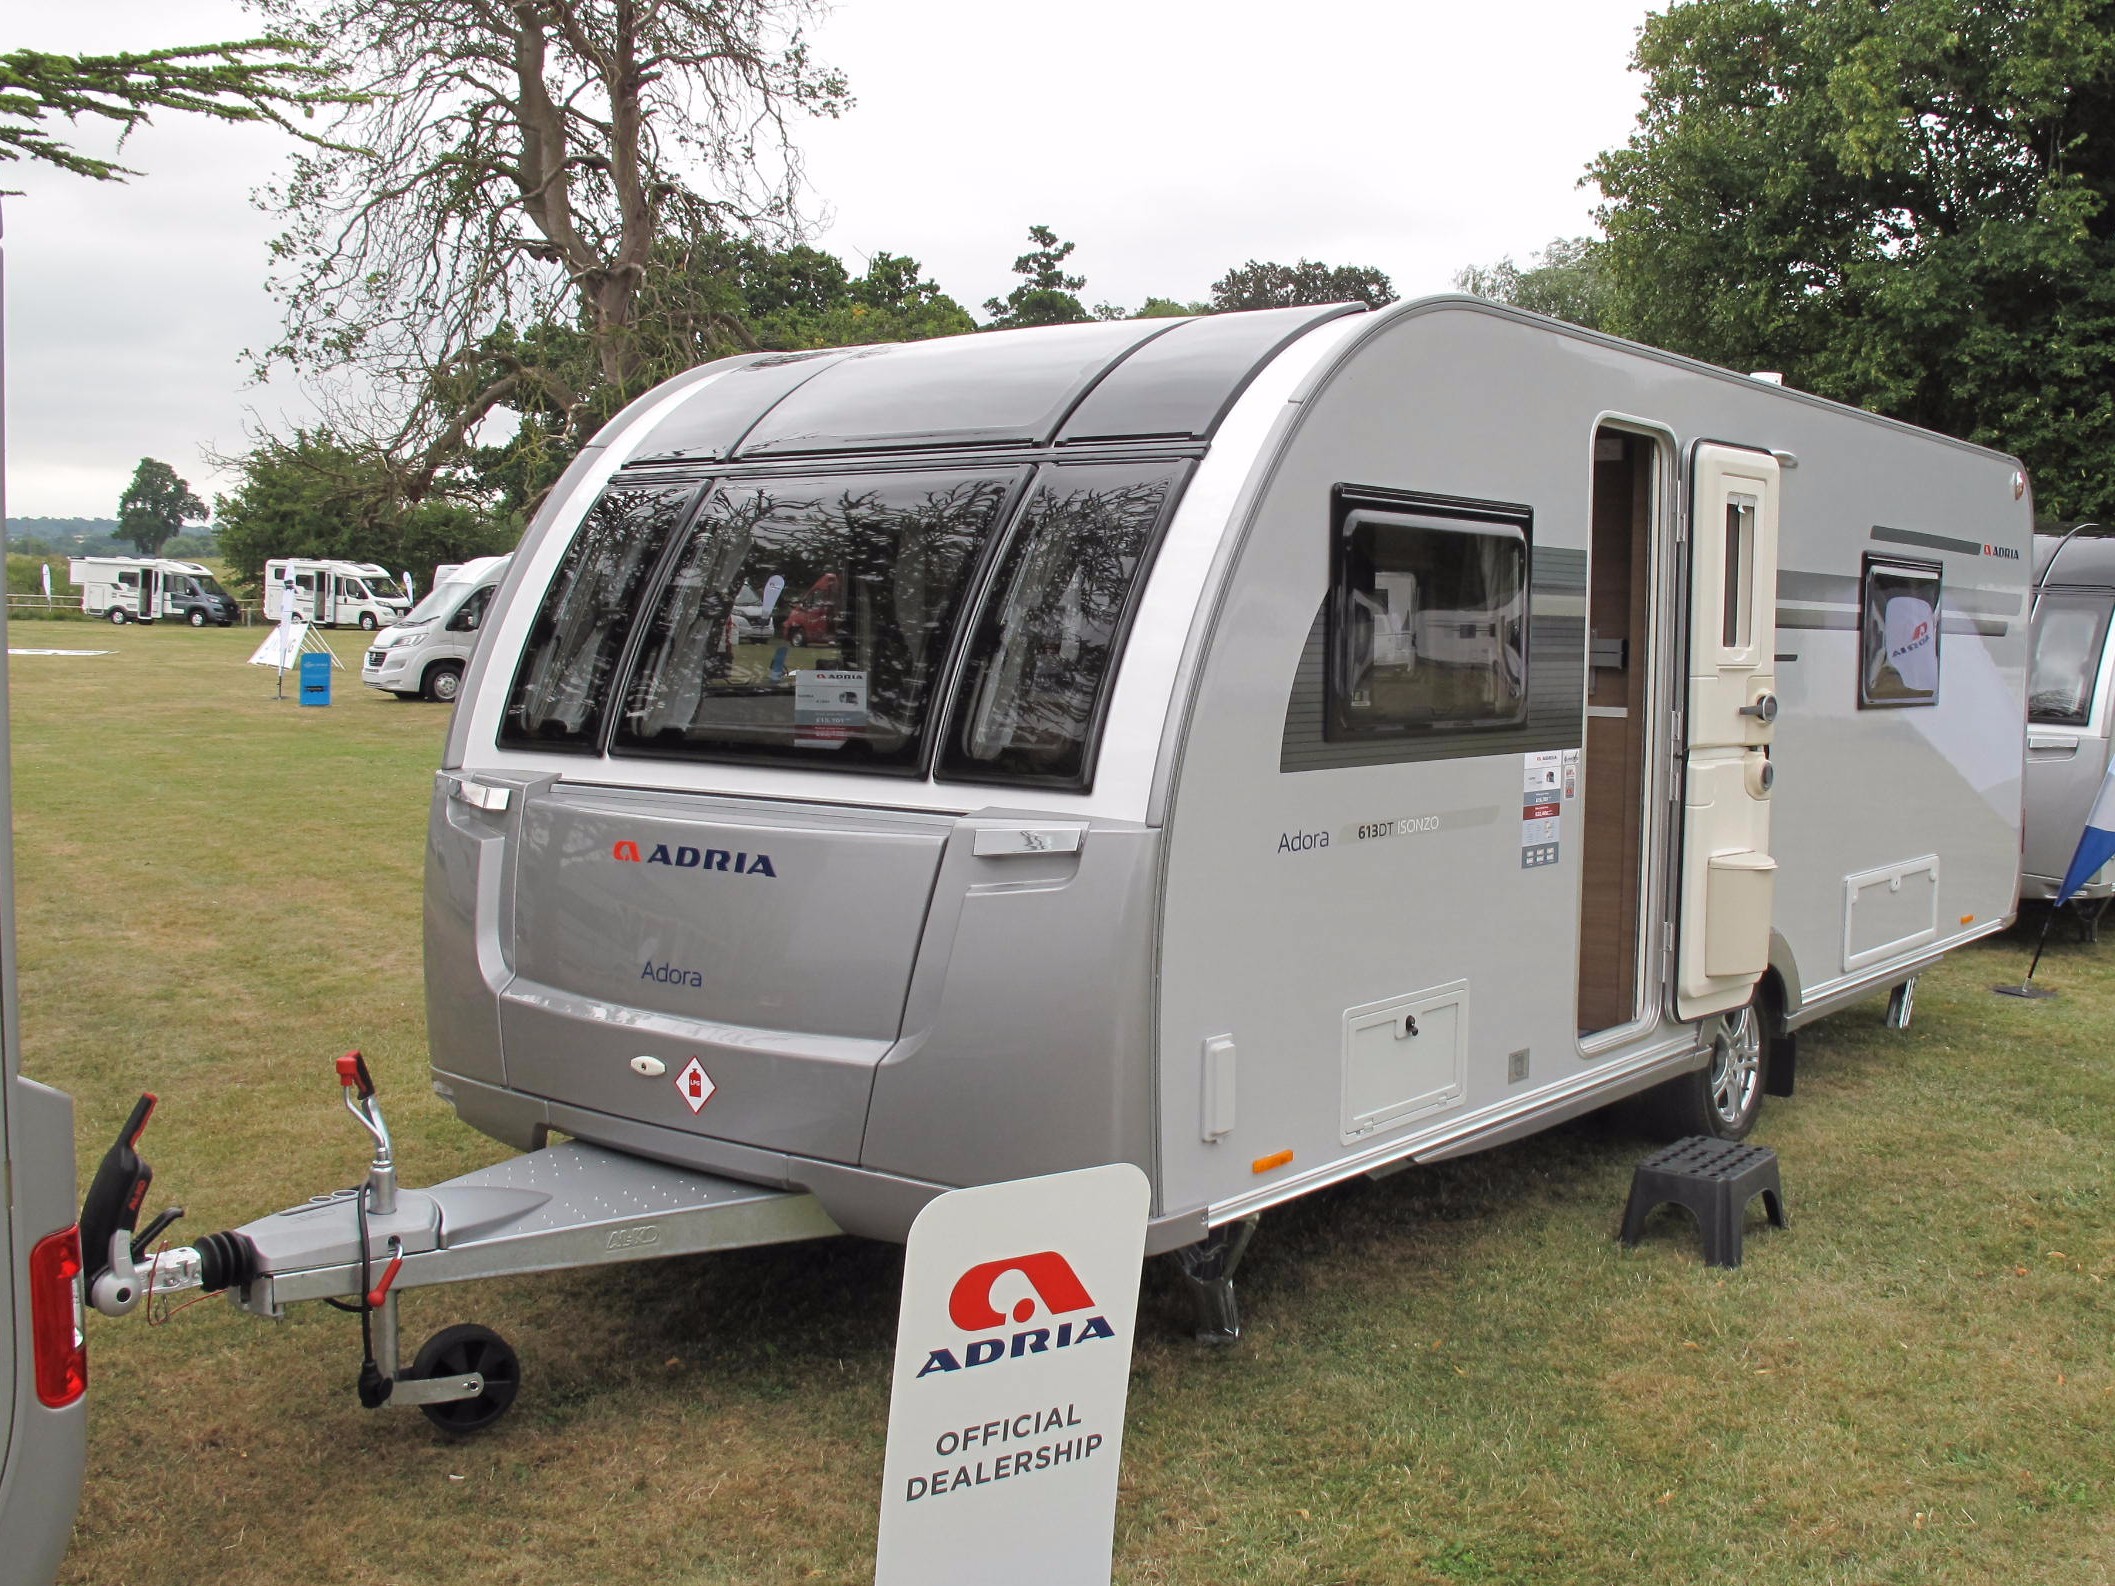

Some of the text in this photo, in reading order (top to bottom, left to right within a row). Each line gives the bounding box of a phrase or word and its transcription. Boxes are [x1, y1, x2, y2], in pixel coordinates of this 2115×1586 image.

[1993, 546, 2019, 560] ADRIA
[1277, 816, 1440, 854] Adora 613DT ISONZO
[647, 843, 777, 878] ADRIA
[641, 960, 702, 988] Adora
[916, 1315, 1115, 1379] ADRIA
[936, 1403, 1081, 1456] OFFICIAL
[906, 1433, 1103, 1502] DEALERSHIP
